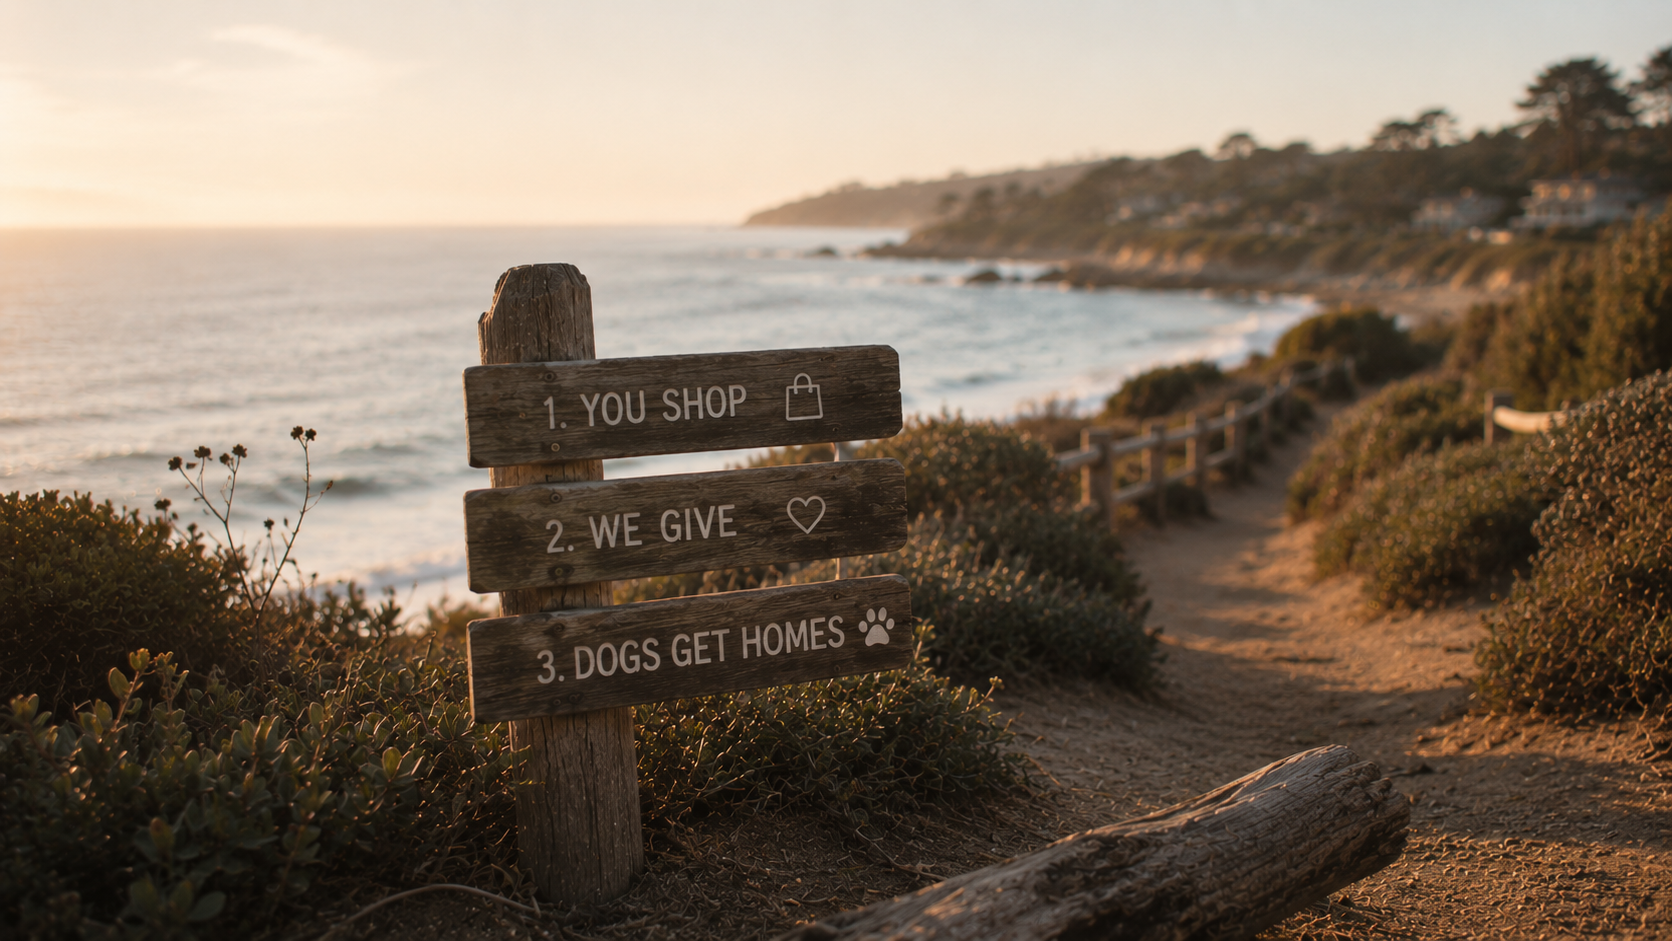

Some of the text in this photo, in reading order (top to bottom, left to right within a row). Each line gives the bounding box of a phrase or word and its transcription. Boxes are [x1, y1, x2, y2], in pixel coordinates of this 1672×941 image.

[544, 385, 747, 430] 1. YOU SHOP
[546, 504, 738, 554] 2. WE GIVE
[537, 615, 845, 684] 3. DOGS GET HOMES
